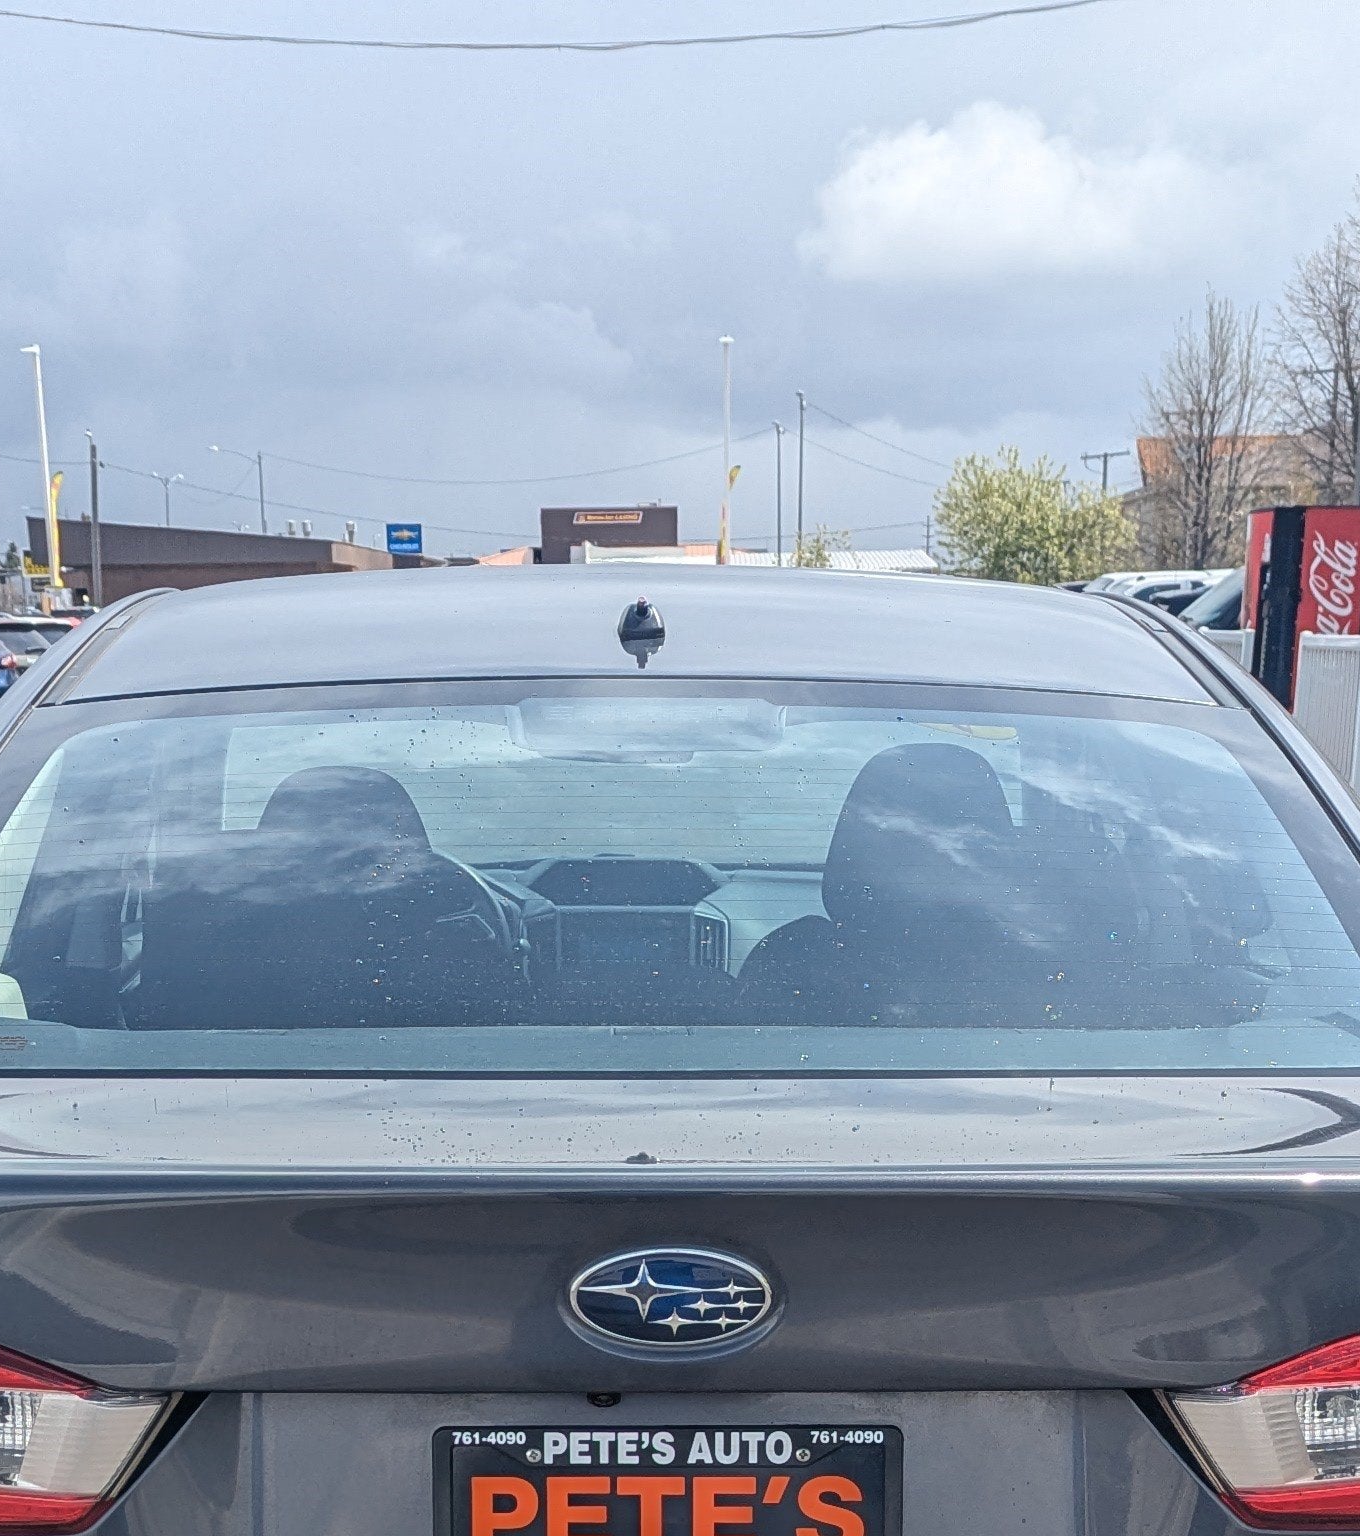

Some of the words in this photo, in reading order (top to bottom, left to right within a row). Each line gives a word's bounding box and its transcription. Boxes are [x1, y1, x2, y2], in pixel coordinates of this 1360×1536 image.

[1309, 530, 1358, 634] a-Cola
[452, 1431, 526, 1446] 761-4090
[544, 1431, 676, 1466] PETE'S
[687, 1431, 793, 1465] AUTO
[810, 1430, 884, 1445] 761-4090
